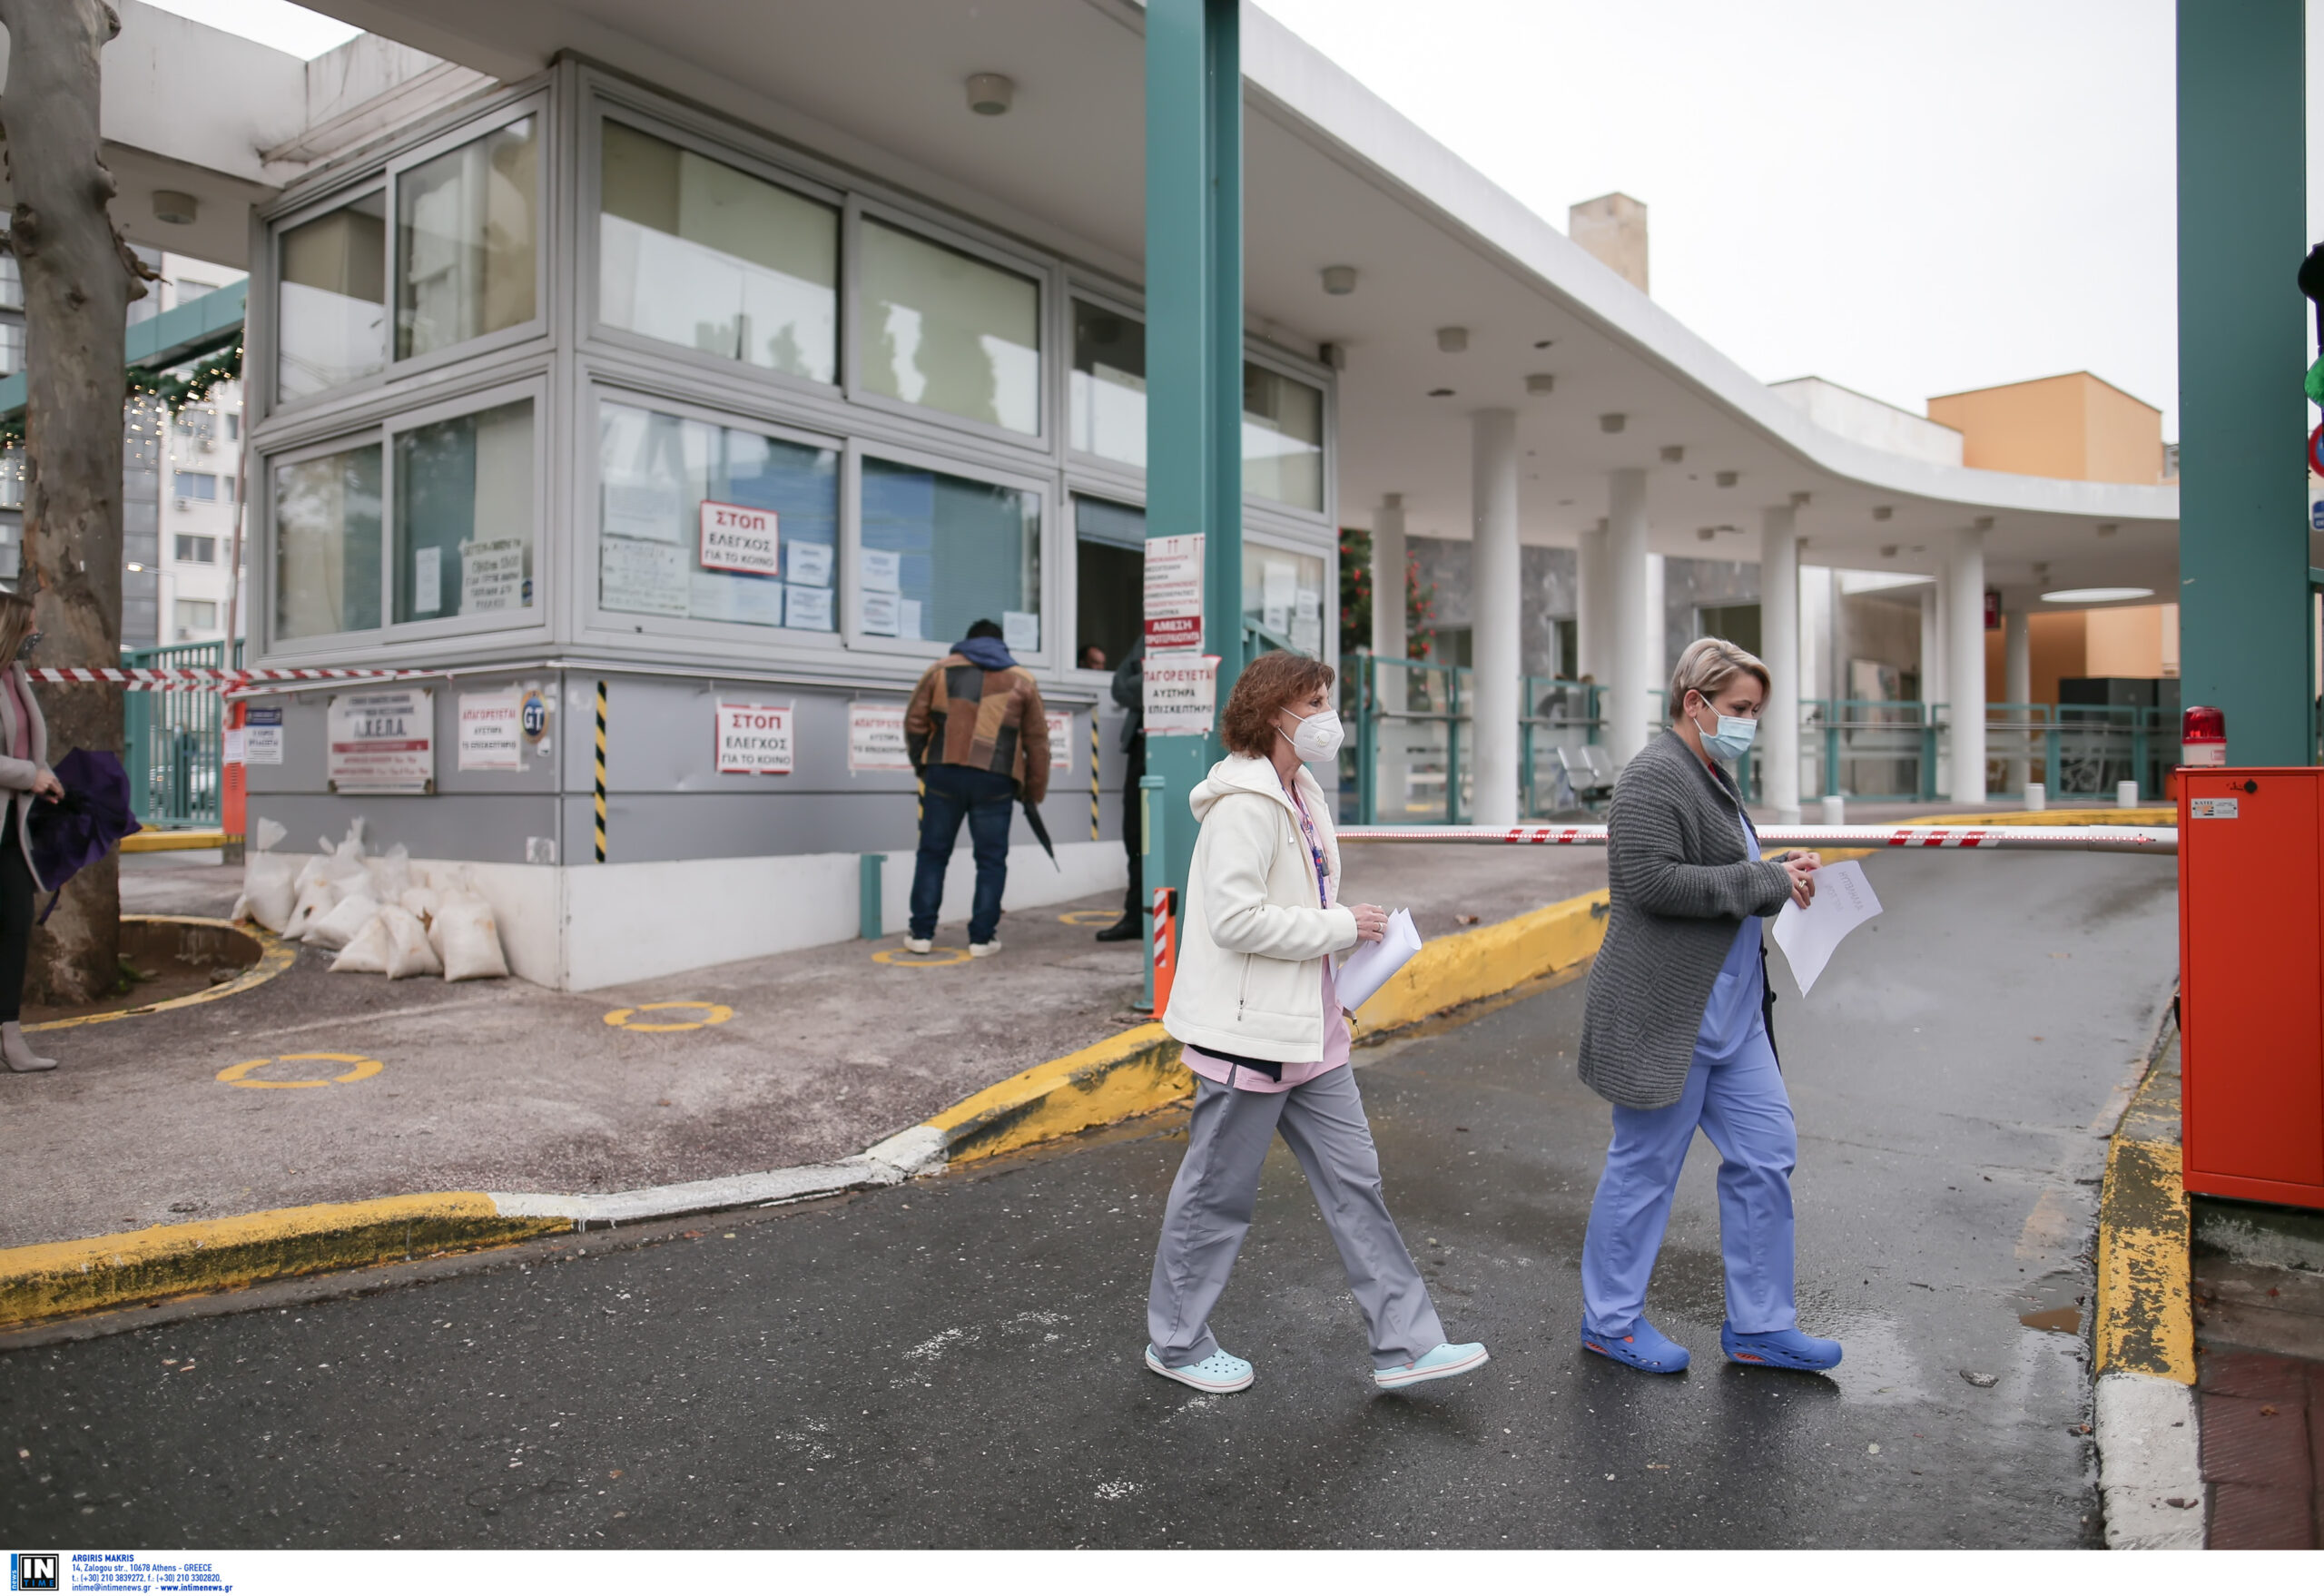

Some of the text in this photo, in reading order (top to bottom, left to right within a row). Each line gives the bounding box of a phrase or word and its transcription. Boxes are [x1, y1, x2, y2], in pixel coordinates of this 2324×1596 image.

[716, 509, 765, 531] ΣΤΟΠ
[709, 532, 771, 553] ΕΛΕΓΧΟΣ
[704, 549, 774, 567] ΓΙΑ ΤΟ ΚΟΙΝΟ
[1152, 619, 1193, 632] ΑΜΕΣΗ
[1153, 688, 1196, 698] ΑΥΣΤΗΡΑ
[524, 705, 544, 732] GT
[732, 714, 781, 730] ΣΤΟΠ
[725, 734, 788, 751] ΕΛΕΓΧΟΣ
[722, 753, 792, 765] ΓΙΑ ΤΟ ΚΟΙΝΟ
